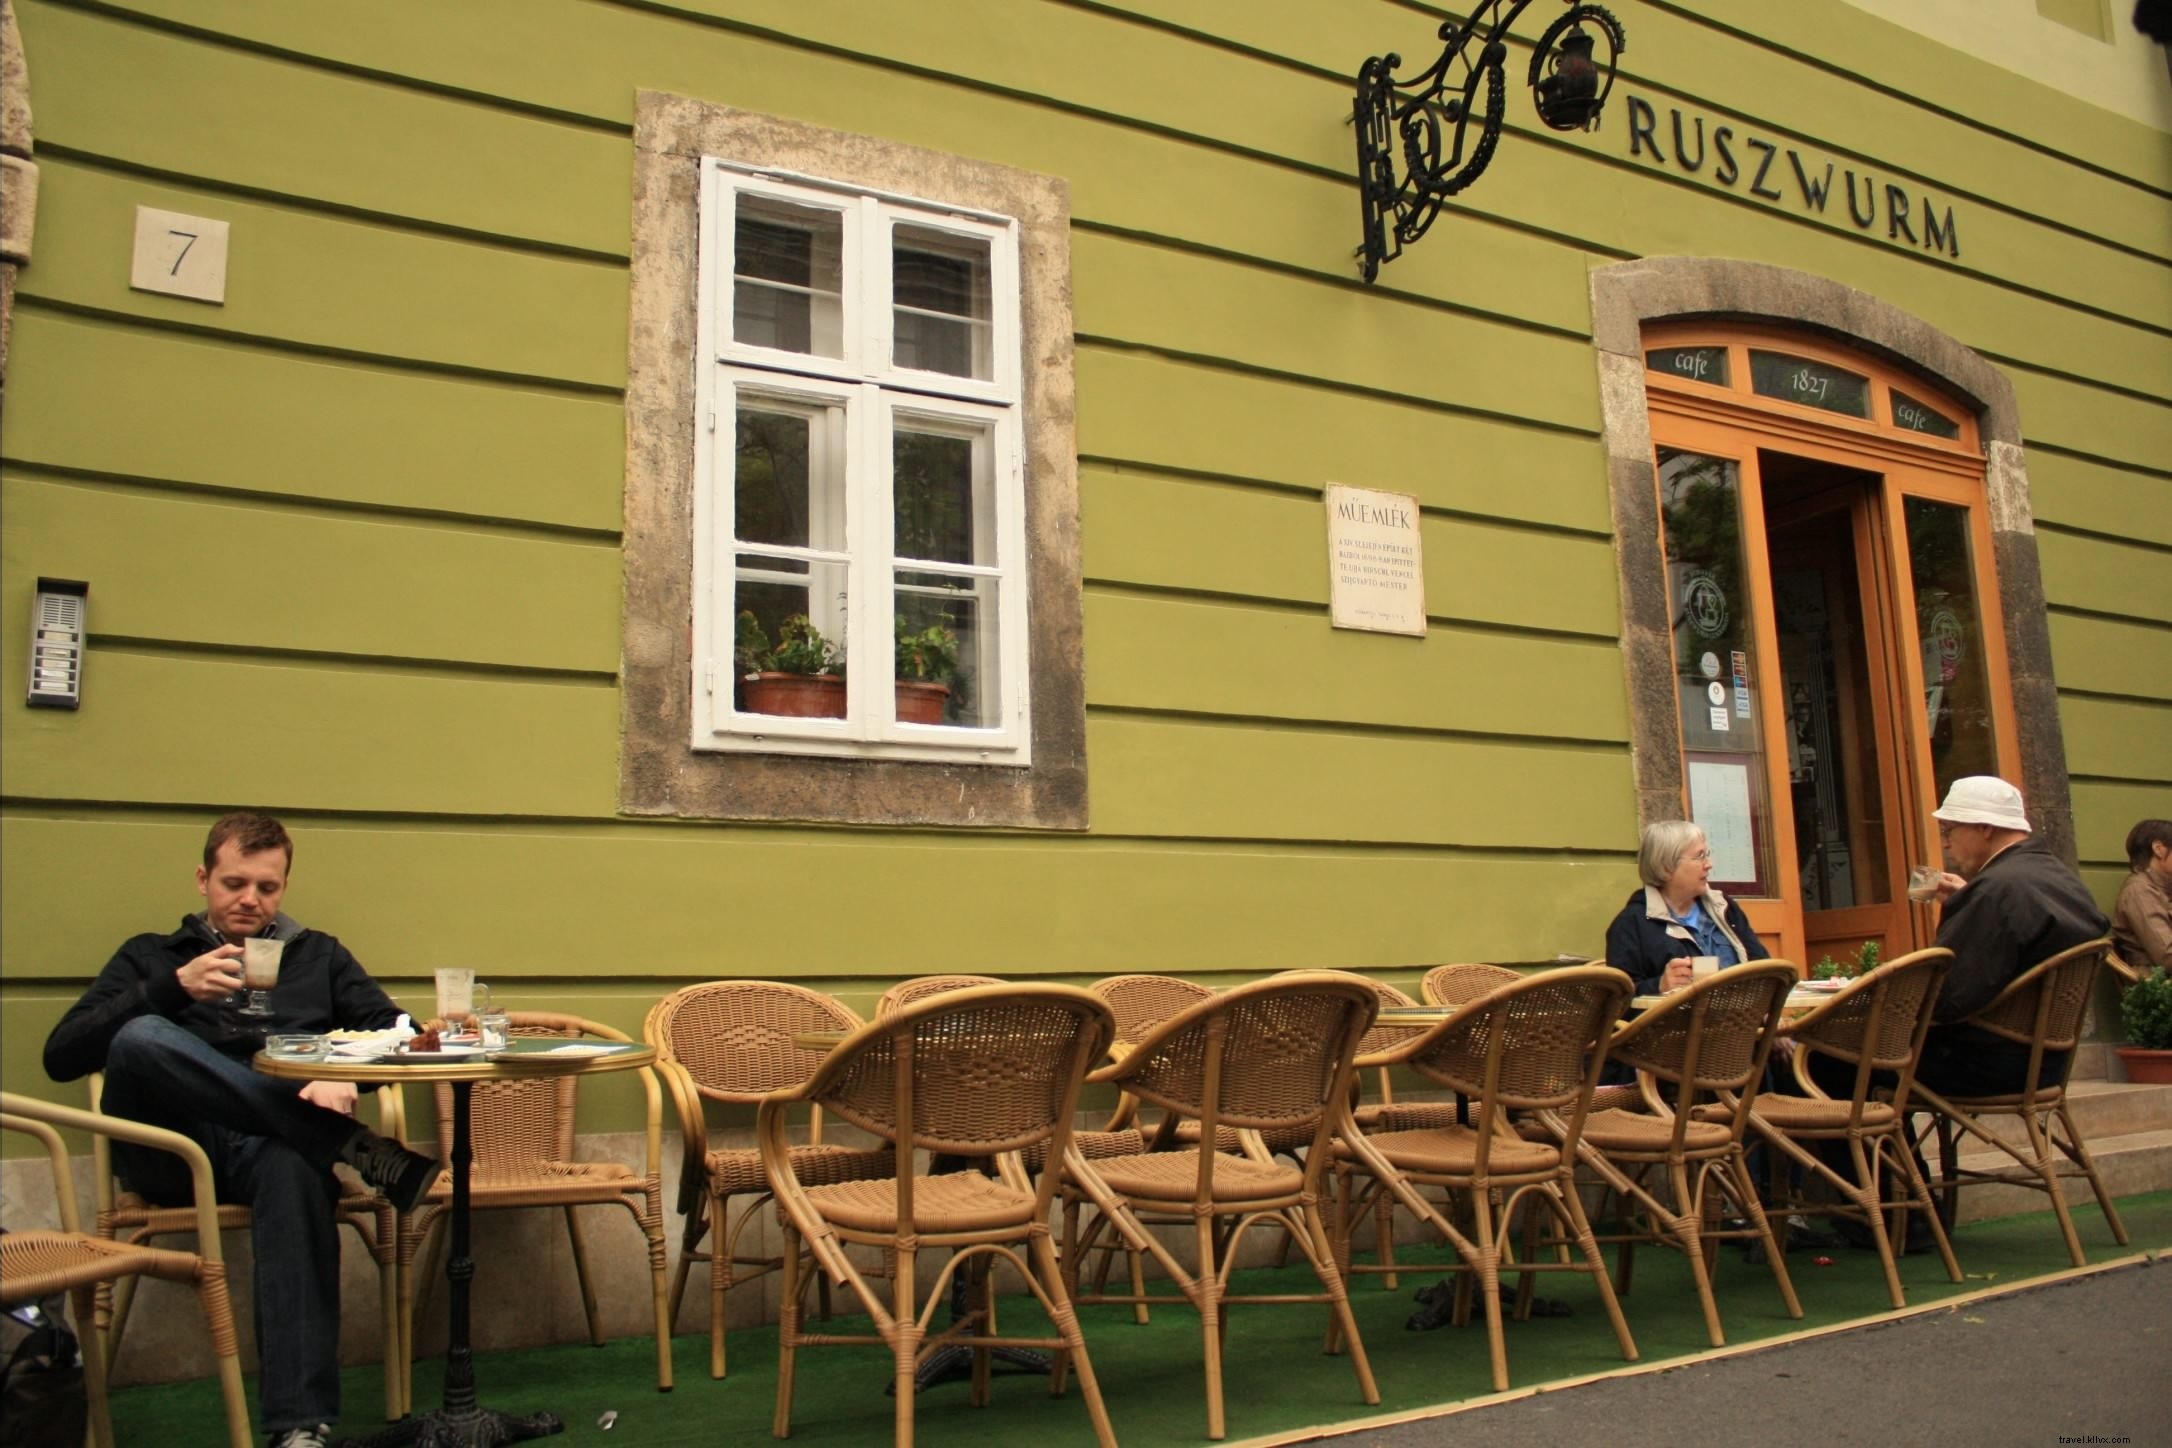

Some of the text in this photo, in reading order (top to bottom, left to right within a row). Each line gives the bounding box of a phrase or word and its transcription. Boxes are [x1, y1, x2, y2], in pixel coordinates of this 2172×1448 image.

[1626, 95, 1960, 257] RUSZWURM
[168, 230, 199, 276] 7
[1791, 369, 1829, 399] 1827
